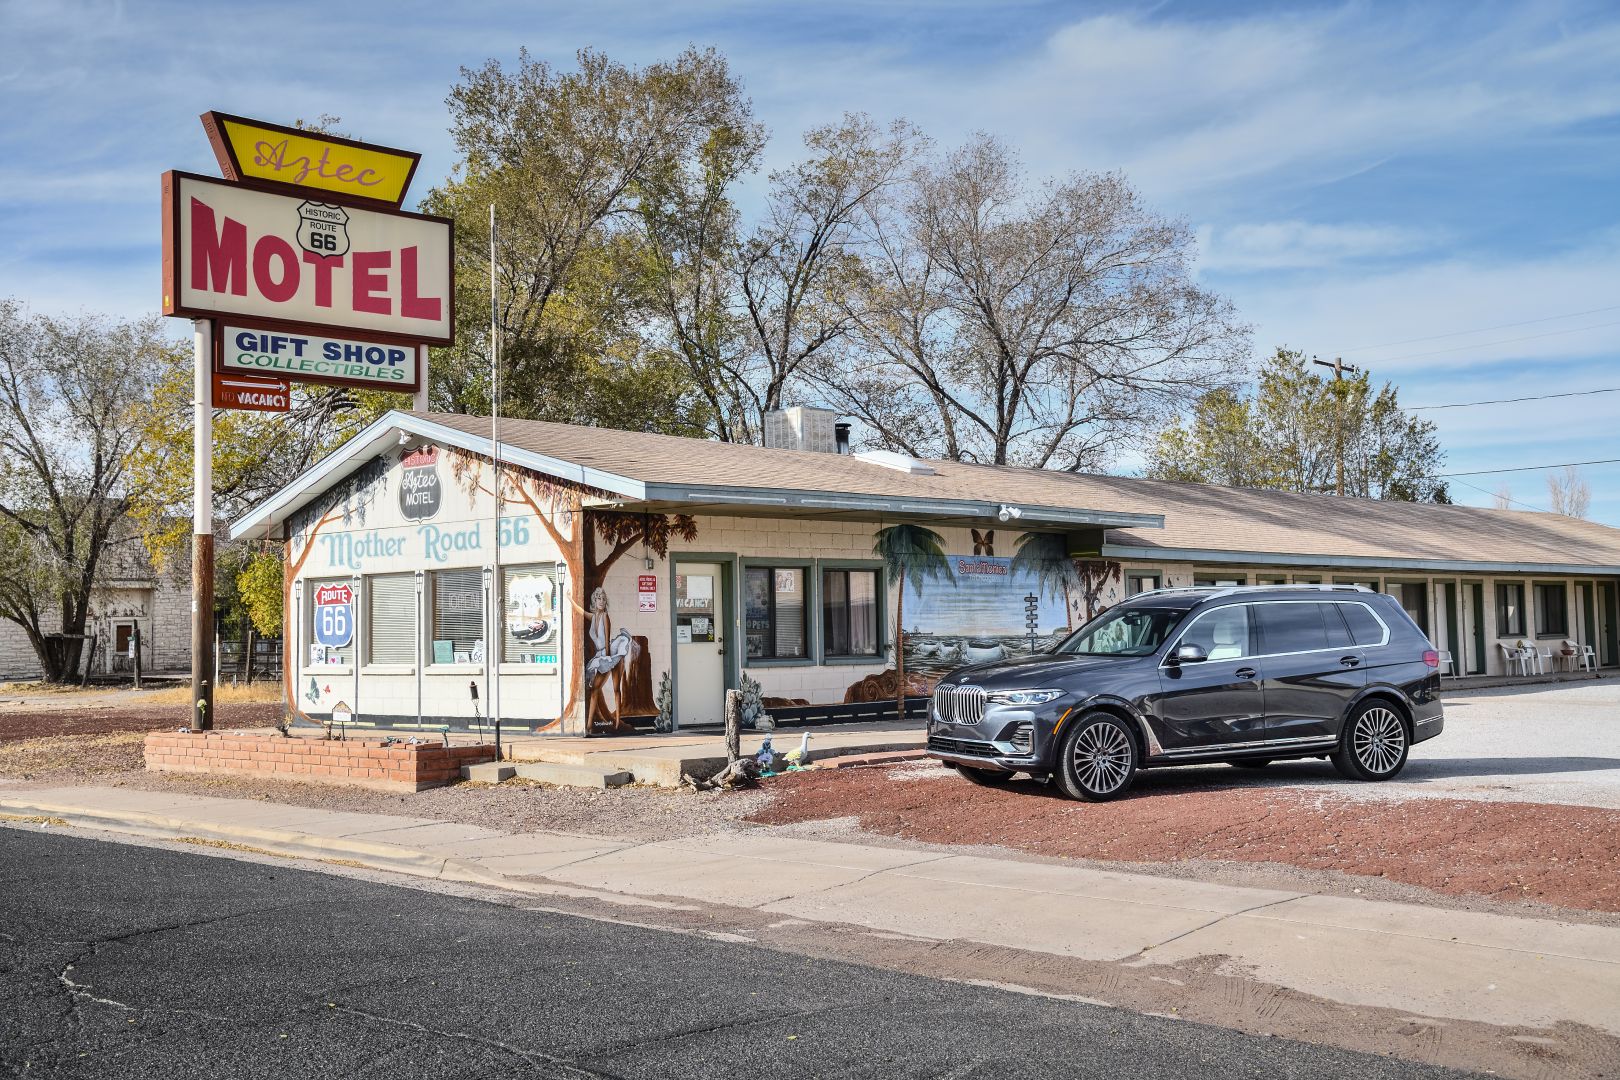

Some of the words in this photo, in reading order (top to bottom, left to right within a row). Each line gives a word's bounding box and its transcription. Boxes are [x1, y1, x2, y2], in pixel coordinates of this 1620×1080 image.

[254, 139, 385, 185] Aztec
[305, 208, 341, 220] HISTORIC
[310, 222, 337, 232] ROUTE
[311, 232, 336, 251] 66
[191, 196, 441, 321] MOTEL
[235, 332, 308, 357] GIFT
[322, 342, 405, 366] SHOP
[237, 353, 405, 380] COLLECTIBLES
[237, 392, 287, 407] VACANCY
[402, 469, 437, 493] Aztec
[405, 492, 434, 506] MOTEL
[319, 529, 406, 570] Mother
[417, 522, 482, 562] Road
[500, 517, 530, 547] 66
[321, 589, 348, 604] ROUTE
[676, 598, 709, 608] VACANCY
[323, 606, 346, 636] 66
[474, 651, 483, 662] 66
